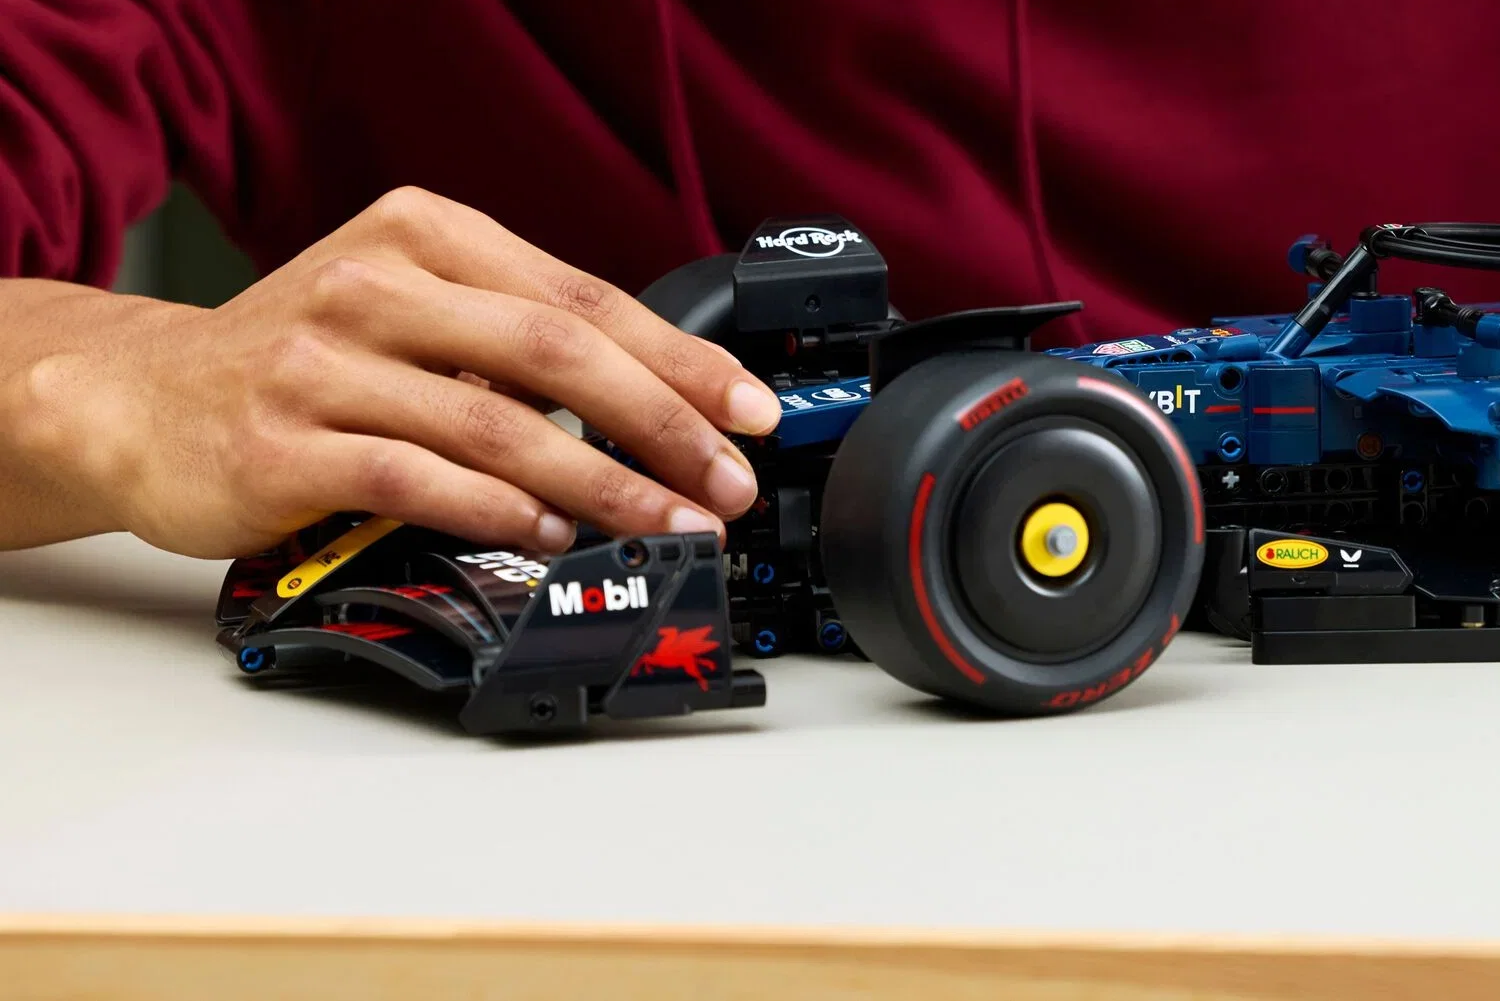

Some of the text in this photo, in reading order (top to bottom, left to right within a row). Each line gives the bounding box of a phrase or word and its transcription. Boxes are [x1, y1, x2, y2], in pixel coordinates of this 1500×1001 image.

[756, 230, 862, 248] Hard Rock
[1276, 549, 1319, 559] RAUCH
[549, 576, 649, 616] Mobil
